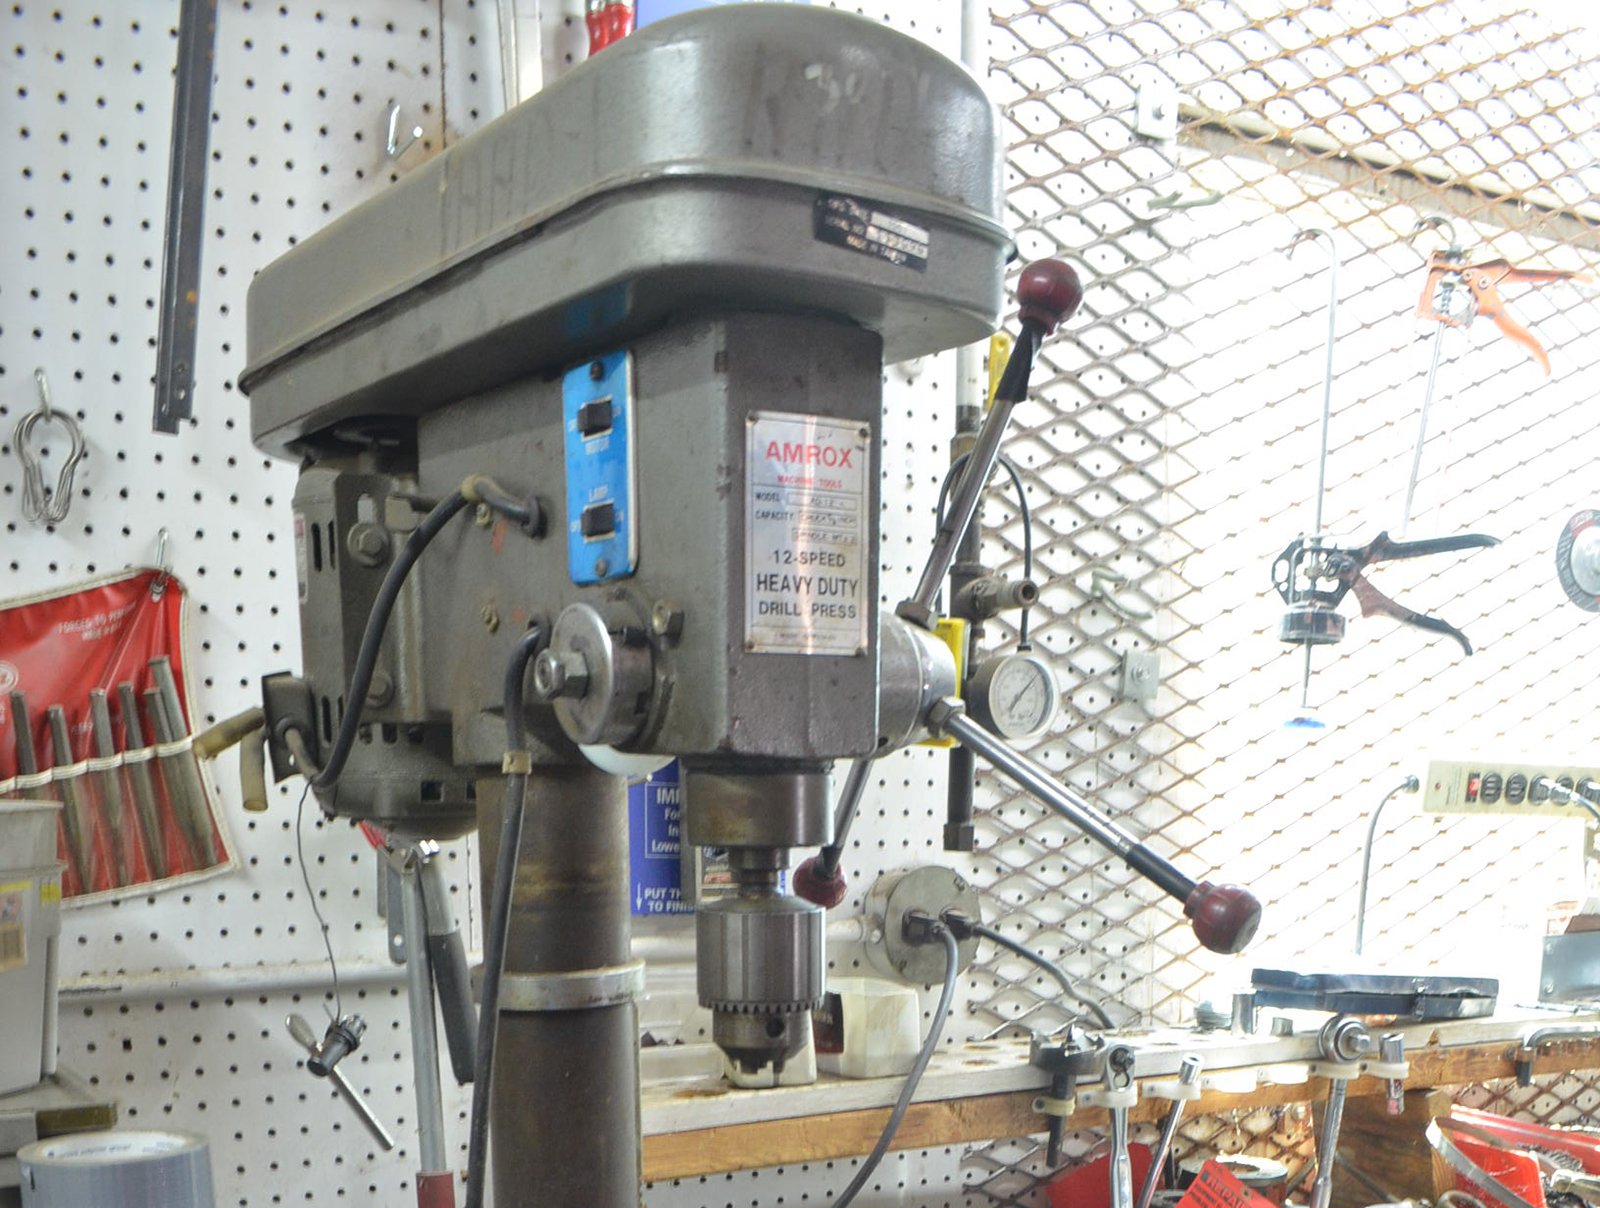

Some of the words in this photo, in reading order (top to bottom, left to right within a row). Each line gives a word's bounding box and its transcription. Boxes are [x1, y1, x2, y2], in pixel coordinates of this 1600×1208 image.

[764, 440, 853, 469] AMROX
[755, 491, 780, 502] MODEL
[755, 510, 794, 521] CAPACITY
[772, 550, 847, 568] 12-SPEED
[756, 573, 813, 596] HEAVY
[817, 577, 859, 599] DUTY
[758, 600, 801, 617] DRILL
[811, 604, 857, 619] PRESS
[651, 839, 681, 853] Lowe
[644, 887, 667, 901] PUT
[648, 900, 663, 913] TO
